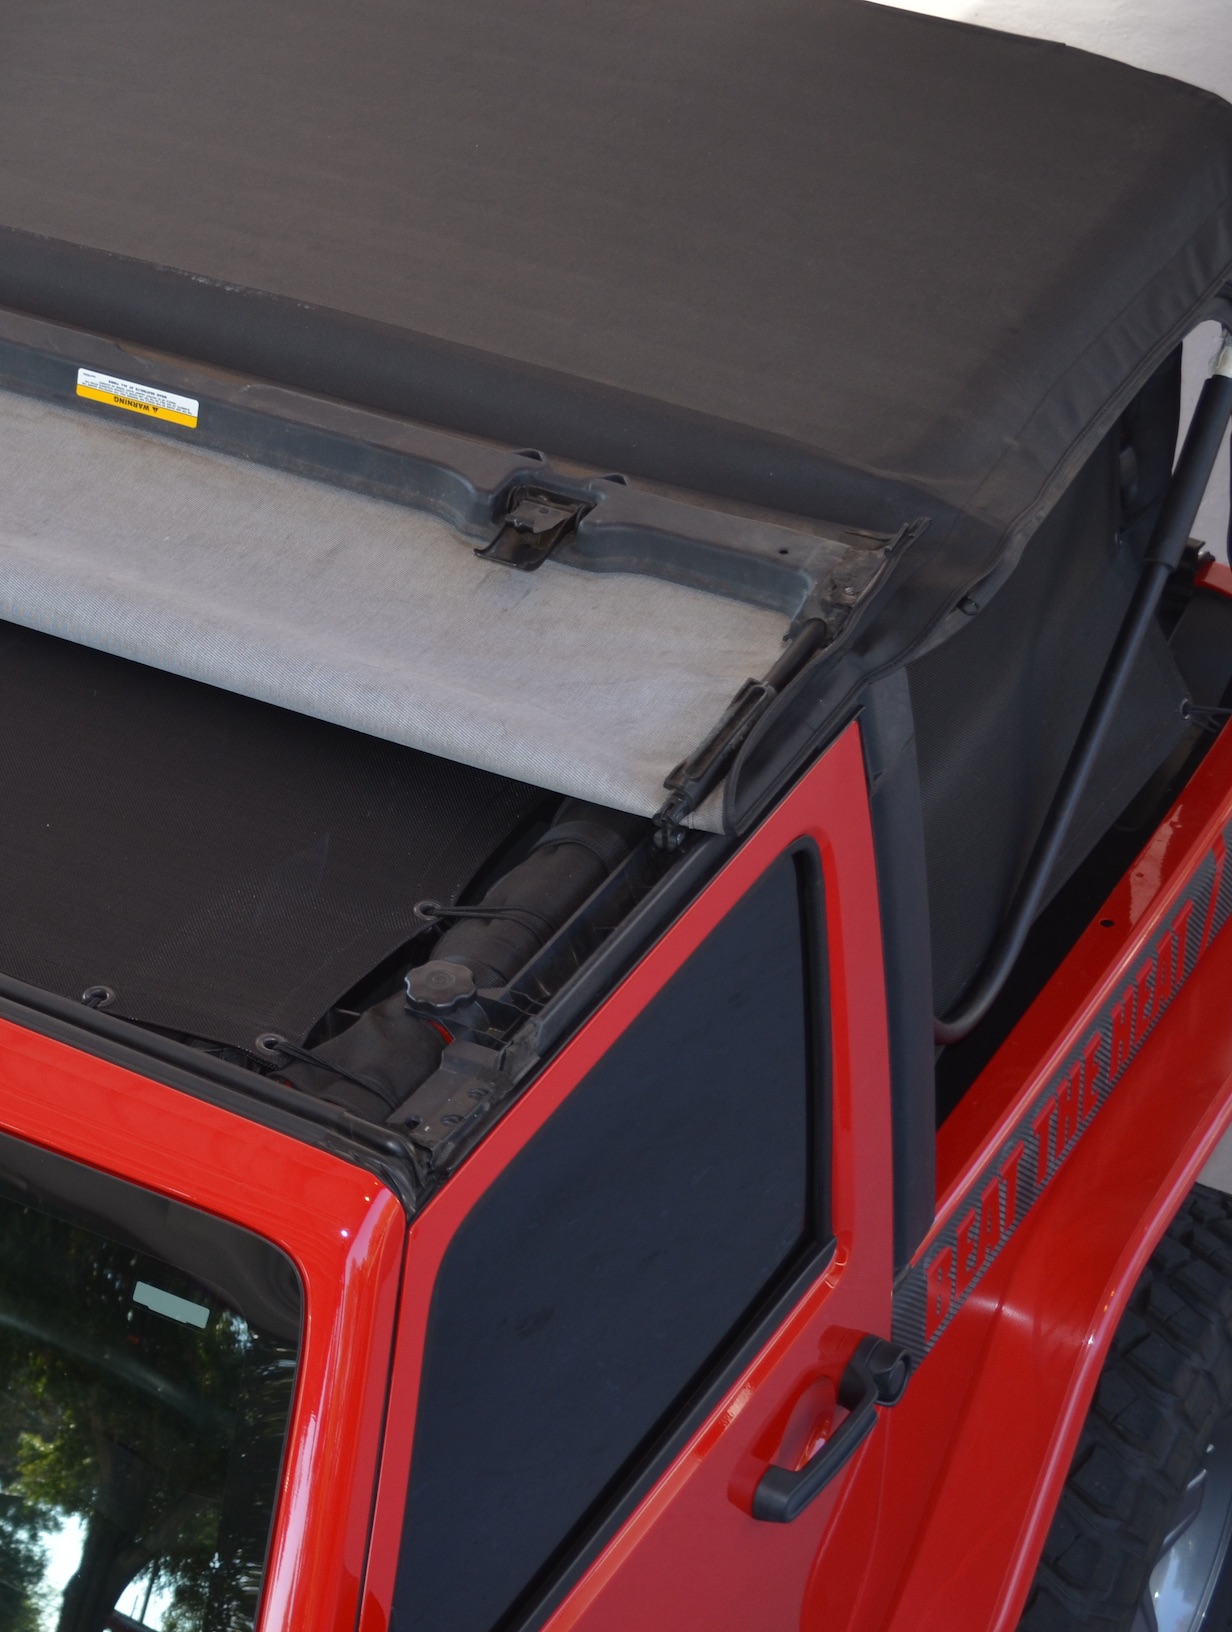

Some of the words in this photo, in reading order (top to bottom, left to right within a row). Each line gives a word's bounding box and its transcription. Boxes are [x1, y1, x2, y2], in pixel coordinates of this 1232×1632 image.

[113, 396, 150, 412] WARNING
[925, 1139, 1024, 1344] BEAT
[1031, 1030, 1101, 1187] THE
[1108, 898, 1194, 1084] HEAT
